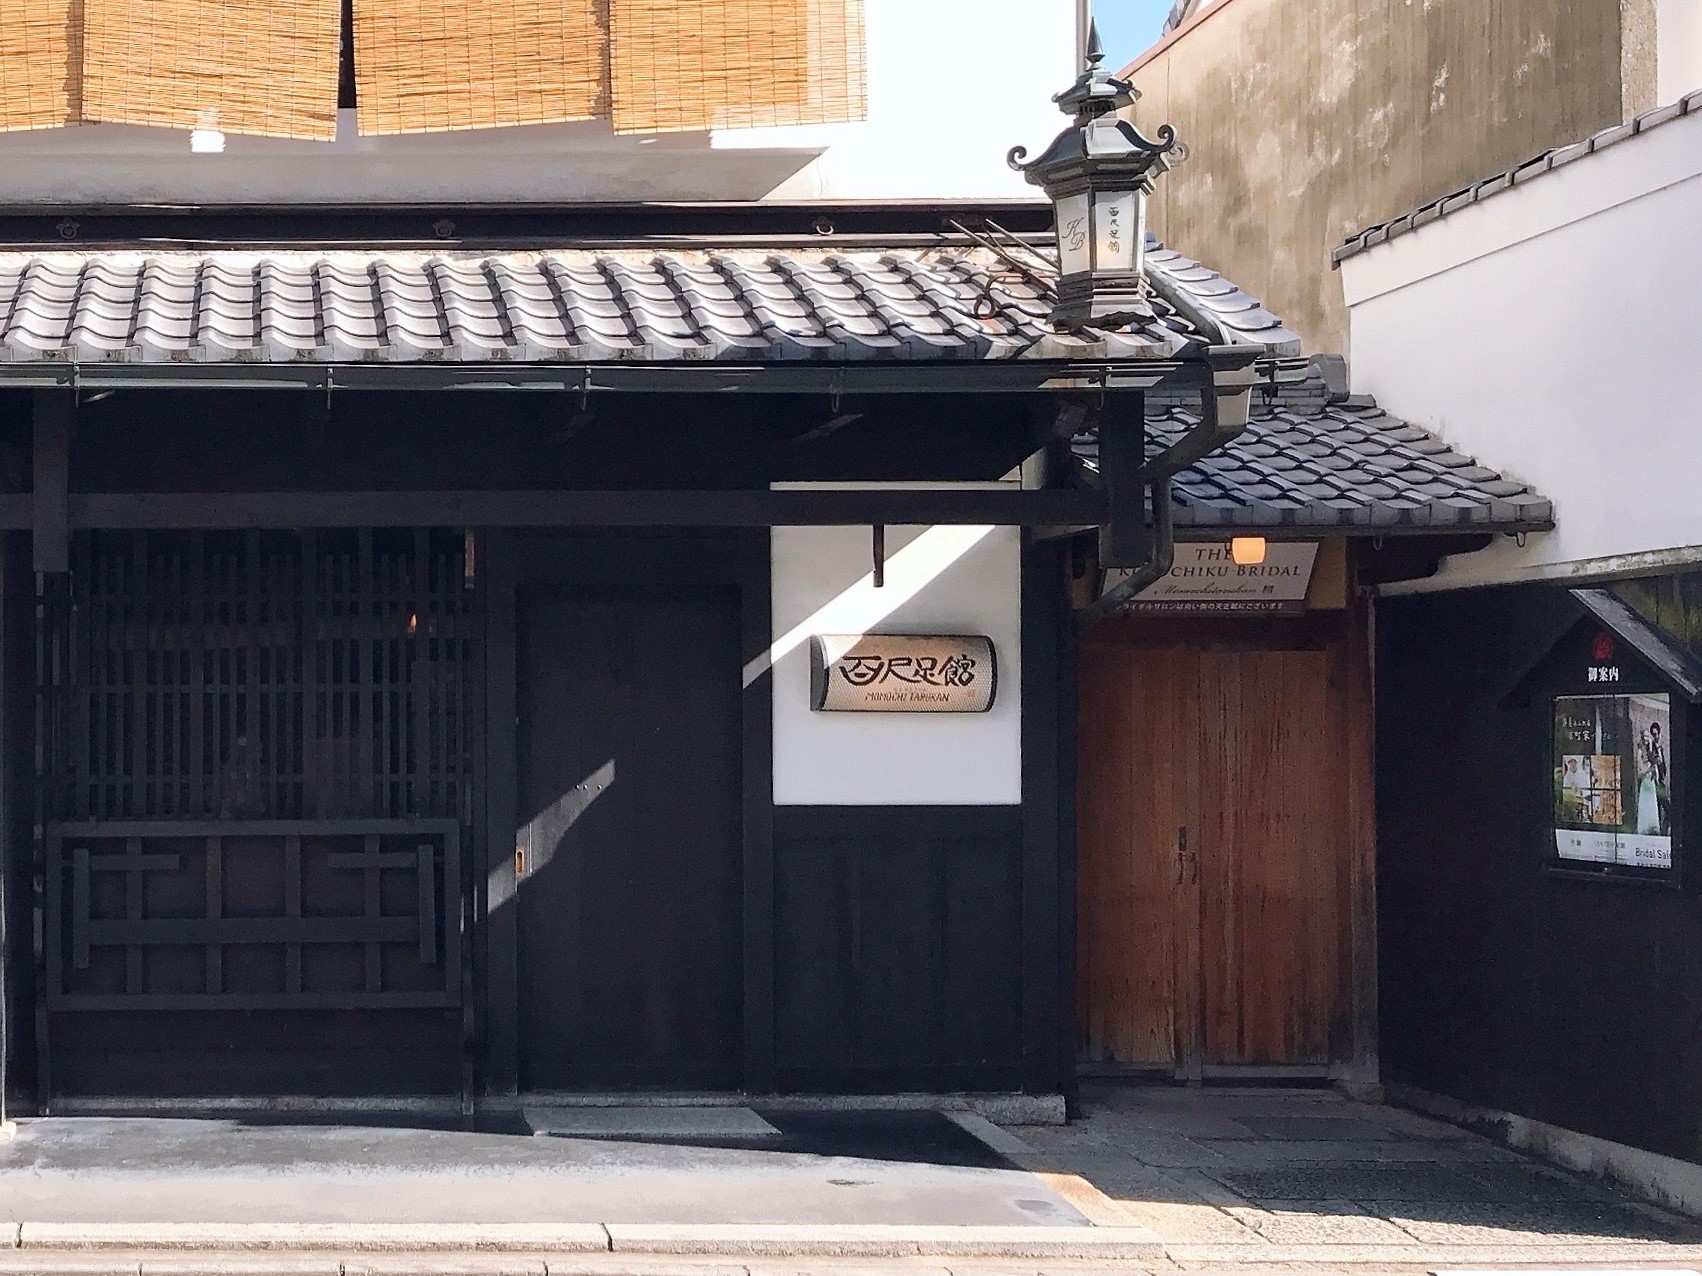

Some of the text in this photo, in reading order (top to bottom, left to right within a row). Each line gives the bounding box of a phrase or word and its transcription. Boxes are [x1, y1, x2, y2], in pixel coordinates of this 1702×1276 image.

[1194, 548, 1232, 561] THE
[1118, 565, 1300, 578] KCHIKU BRIDAL
[1587, 666, 1619, 683] 御案内
[909, 692, 950, 702] TARUKAN
[1635, 847, 1655, 859] Bridal
